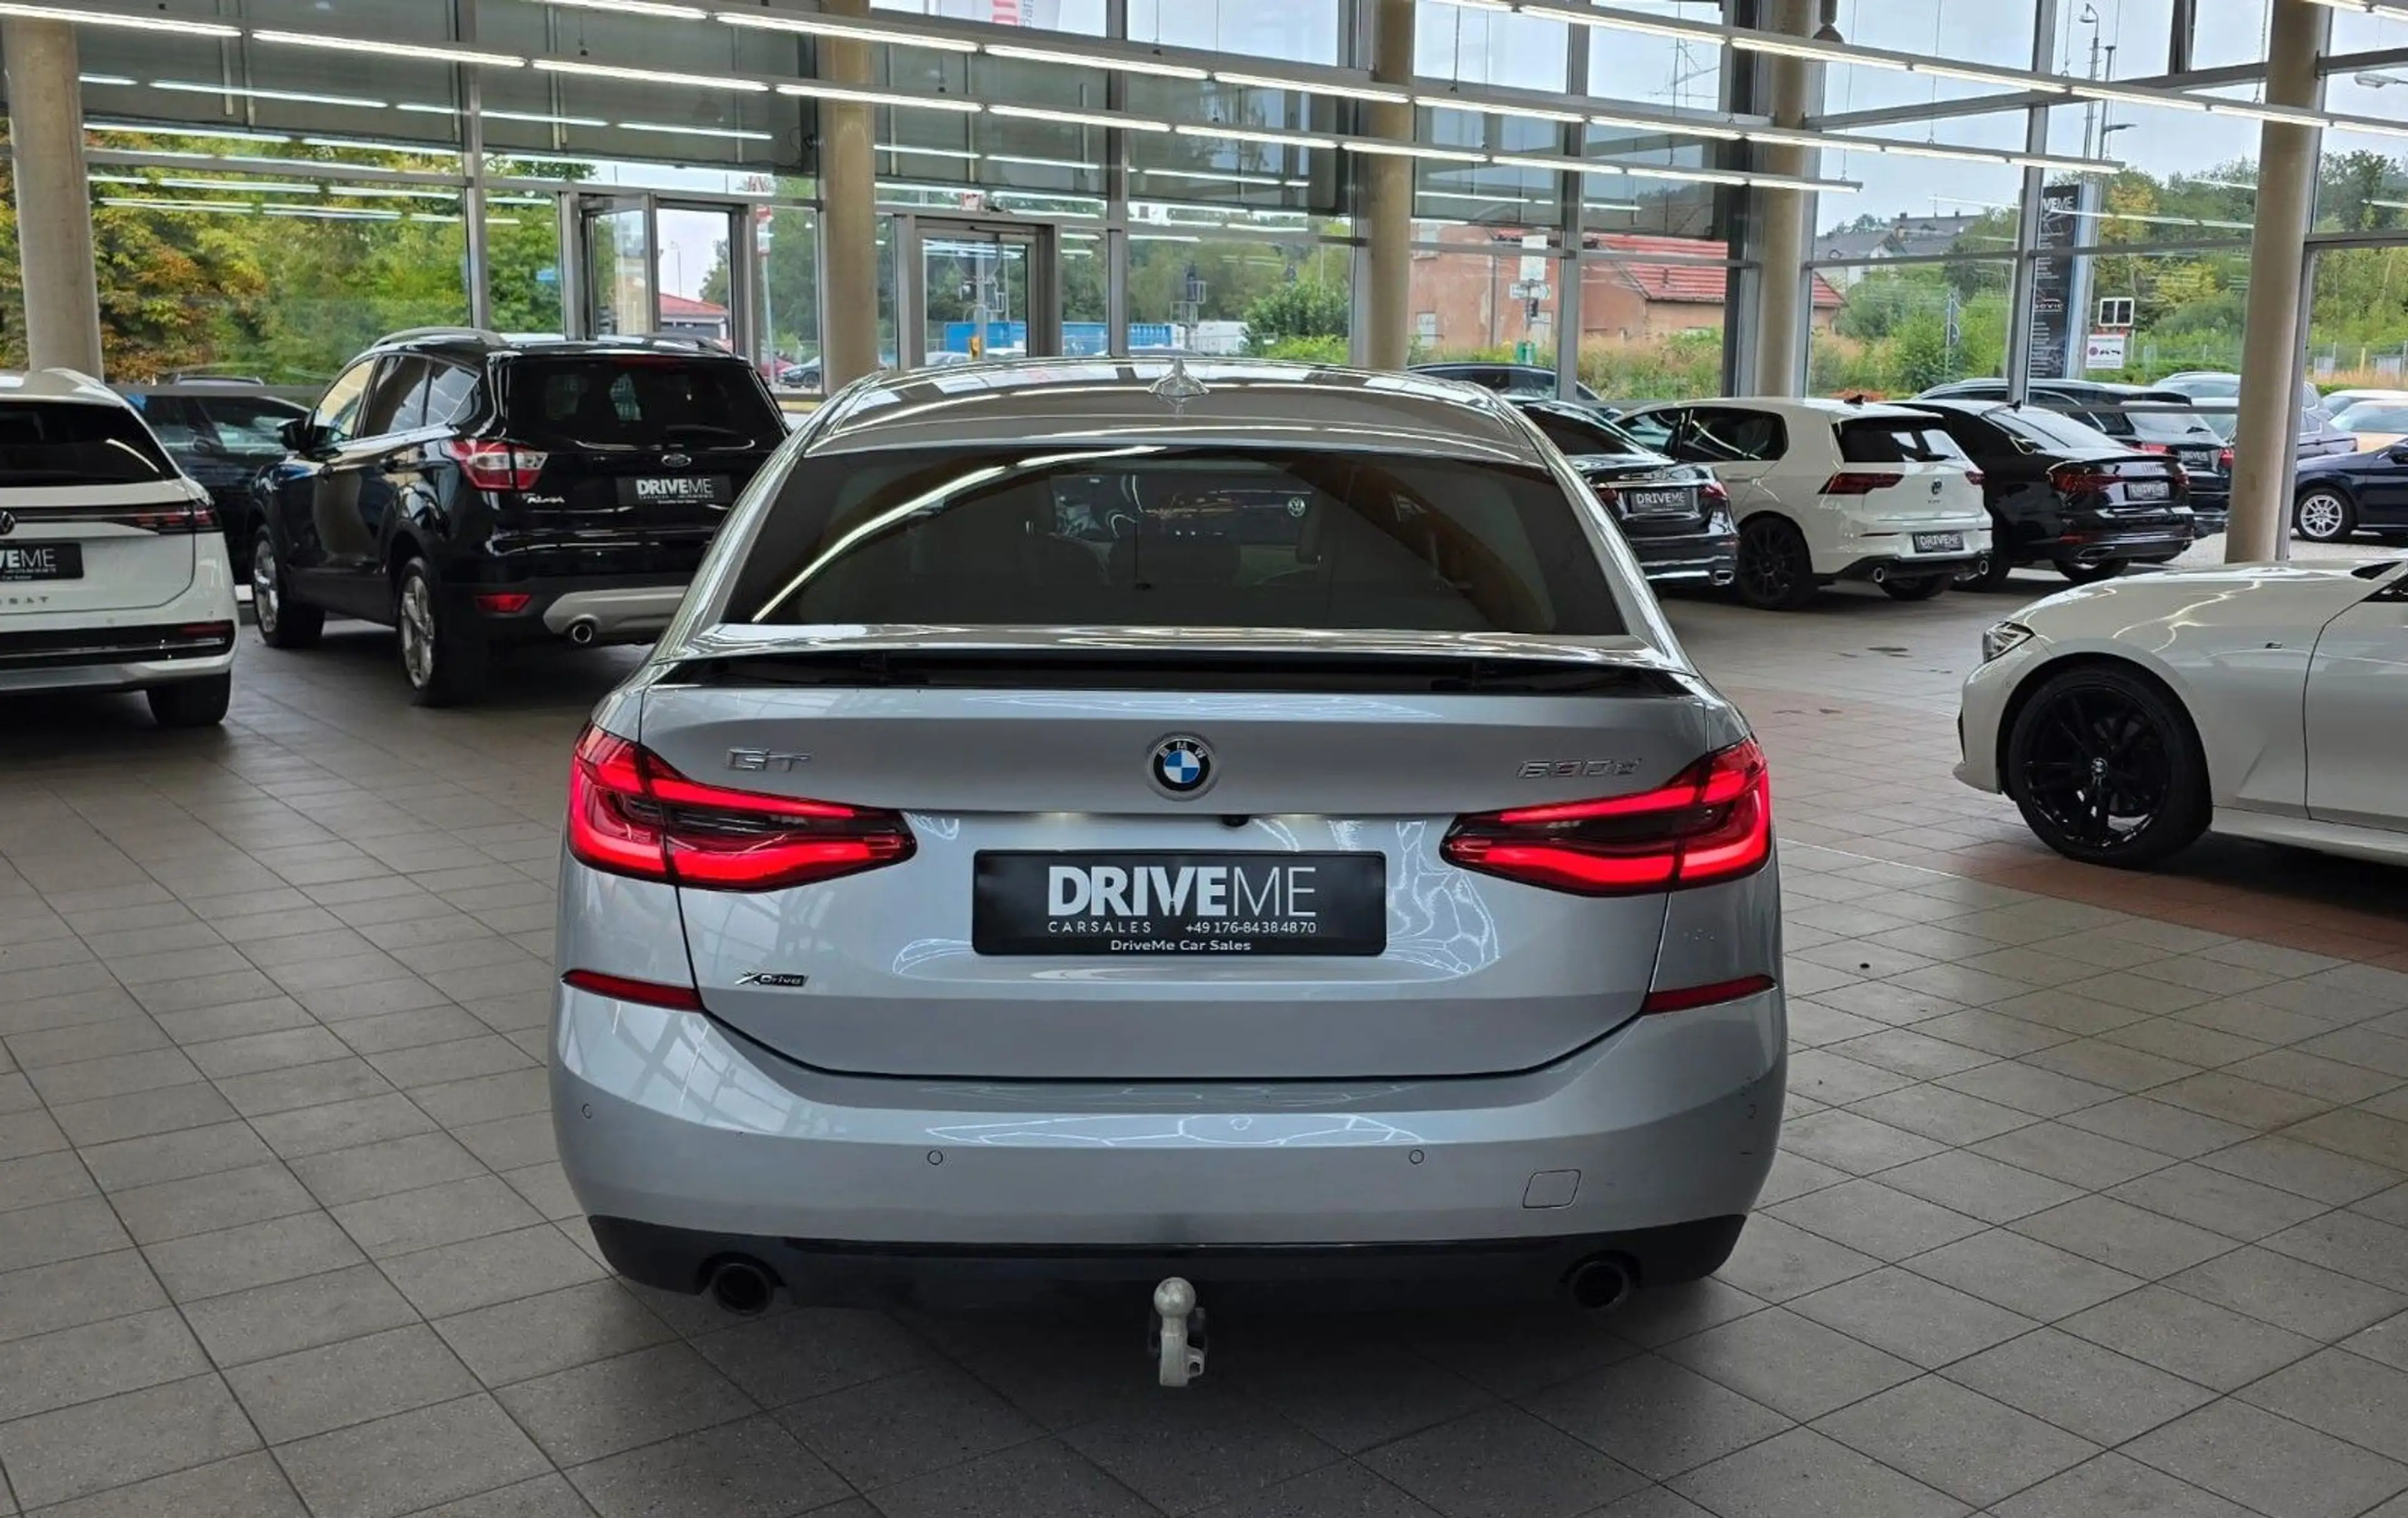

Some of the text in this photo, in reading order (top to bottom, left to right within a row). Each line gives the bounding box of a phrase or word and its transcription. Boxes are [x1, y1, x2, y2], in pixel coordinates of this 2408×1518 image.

[636, 478, 713, 495] DRIVEME
[1636, 492, 1686, 504] DRIVEME
[1159, 742, 1207, 758] BMW
[727, 748, 811, 772] GT
[1048, 866, 1316, 917] DRIVEME
[1048, 921, 1151, 933] CARSALES
[1186, 921, 1210, 933] +49
[1111, 940, 1251, 950] DriveMe Car Sales
